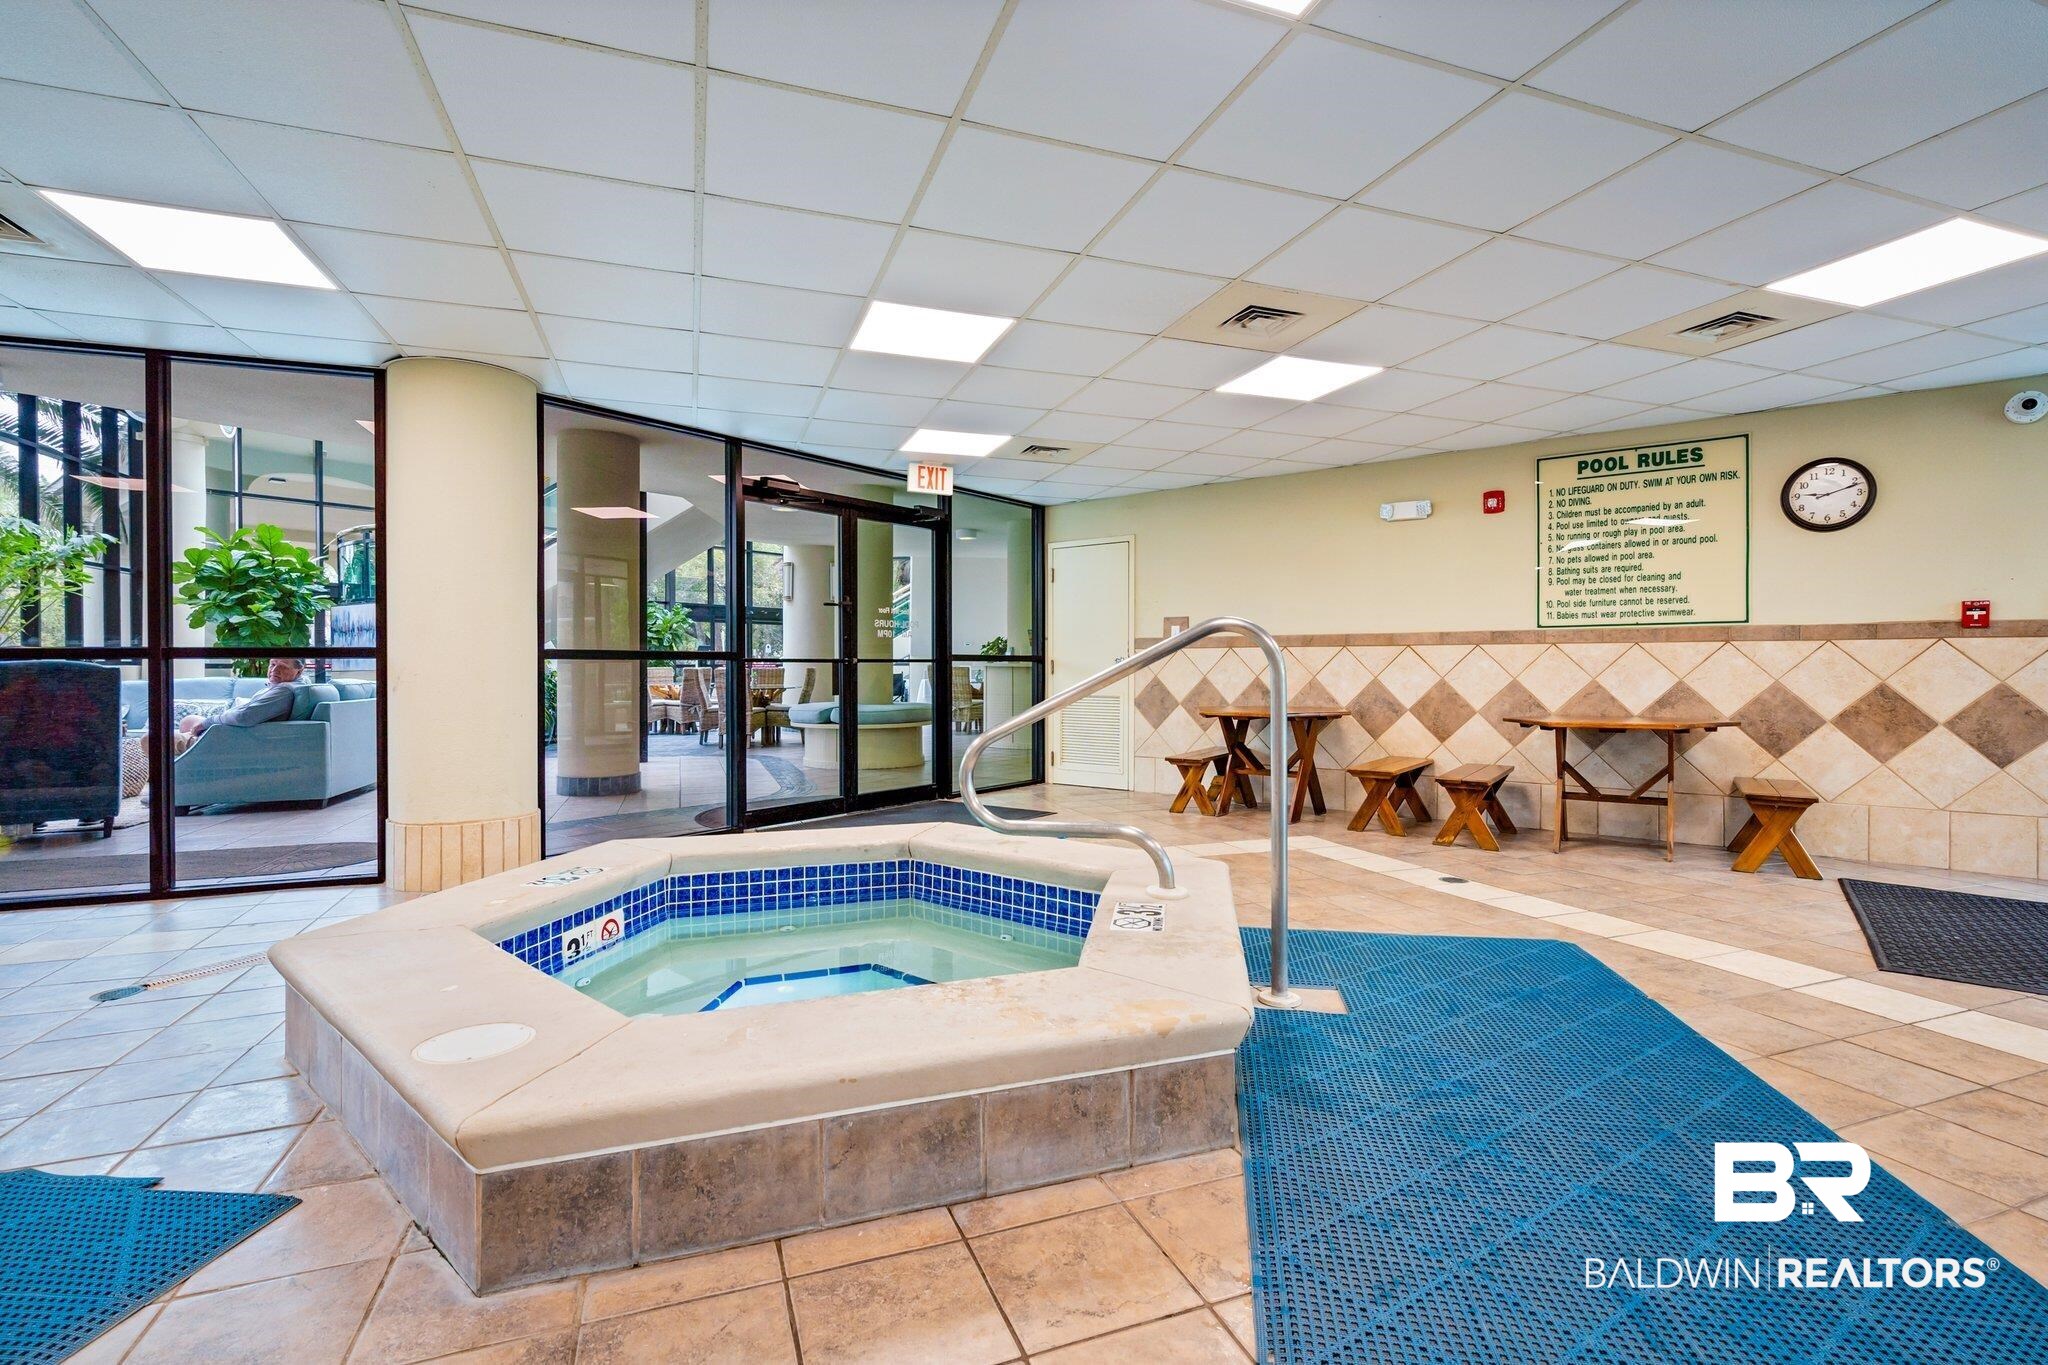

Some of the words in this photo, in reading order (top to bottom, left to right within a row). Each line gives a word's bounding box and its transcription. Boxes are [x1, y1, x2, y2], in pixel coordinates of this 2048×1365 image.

[1577, 456, 1629, 474] POOL
[1637, 447, 1704, 468] RULES
[917, 465, 947, 491] EXIT
[1549, 489, 1554, 497] 1.
[1556, 487, 1566, 497] NO
[1568, 484, 1605, 495] LIFEGUARD
[1607, 482, 1617, 491] ON
[1620, 481, 1640, 490] DUTY.
[1643, 478, 1662, 488] SWIM
[1665, 477, 1674, 486] AT
[1676, 474, 1696, 484] YOUR
[1699, 472, 1717, 482] OWN
[1720, 470, 1740, 480] RISK.
[1852, 477, 1858, 485] 2
[1856, 488, 1863, 496] 3
[1548, 500, 1554, 508] 2.
[1557, 499, 1566, 507] NO
[1568, 497, 1592, 506] DIVING.
[1798, 504, 1805, 512] 8
[1548, 512, 1554, 520] 3.
[1556, 509, 1582, 519] Children
[1603, 507, 1612, 515] be
[1614, 502, 1660, 514] accompanied
[1663, 502, 1671, 511] by
[1686, 499, 1706, 508] adult.
[1809, 512, 1815, 520] 7
[1556, 522, 1570, 530] Pool
[1587, 519, 1608, 527] limited
[1824, 514, 1831, 522] 6
[1556, 533, 1564, 541] No
[1567, 531, 1590, 540] running
[1602, 529, 1621, 538] rough
[1624, 528, 1638, 537] play
[1641, 527, 1647, 535] in
[1649, 526, 1665, 535] pool
[1668, 525, 1685, 533] area.
[1548, 545, 1554, 553] 6.
[1587, 541, 1621, 550] containers
[1624, 539, 1650, 548] allowed
[1653, 538, 1659, 546] in
[1672, 535, 1697, 545] around
[1699, 534, 1718, 544] pool.
[1548, 556, 1554, 564] 7.
[1556, 556, 1564, 564] No
[1567, 556, 1581, 564] pets
[1584, 553, 1609, 562] allowed
[1620, 552, 1635, 562] pool
[1638, 551, 1654, 559] area.
[1548, 568, 1554, 576] 8.
[1556, 566, 1580, 576] Bathing
[1583, 565, 1598, 574] suits
[1614, 563, 1643, 573] required.
[1548, 578, 1554, 586] 9.
[1556, 577, 1570, 585] Pool
[1588, 576, 1596, 584] be
[1599, 574, 1621, 583] closed
[1624, 574, 1634, 582] for
[1636, 572, 1665, 582] cleaning
[1668, 571, 1681, 580] and
[1585, 587, 1616, 595] treatment
[1639, 585, 1678, 593] necessary.
[1546, 600, 1554, 608] 10.
[1557, 600, 1570, 608] Pool
[1573, 599, 1586, 607] side
[1589, 599, 1616, 607] furniture
[1619, 597, 1643, 606] cannot
[1645, 597, 1654, 605] be
[1656, 595, 1690, 604] reserved.
[1546, 612, 1555, 620] 11.
[1556, 611, 1579, 620] Babies
[1619, 609, 1655, 618] protective
[1658, 608, 1696, 616] swimwear.
[566, 937, 580, 959] 3
[586, 930, 594, 939] FT
